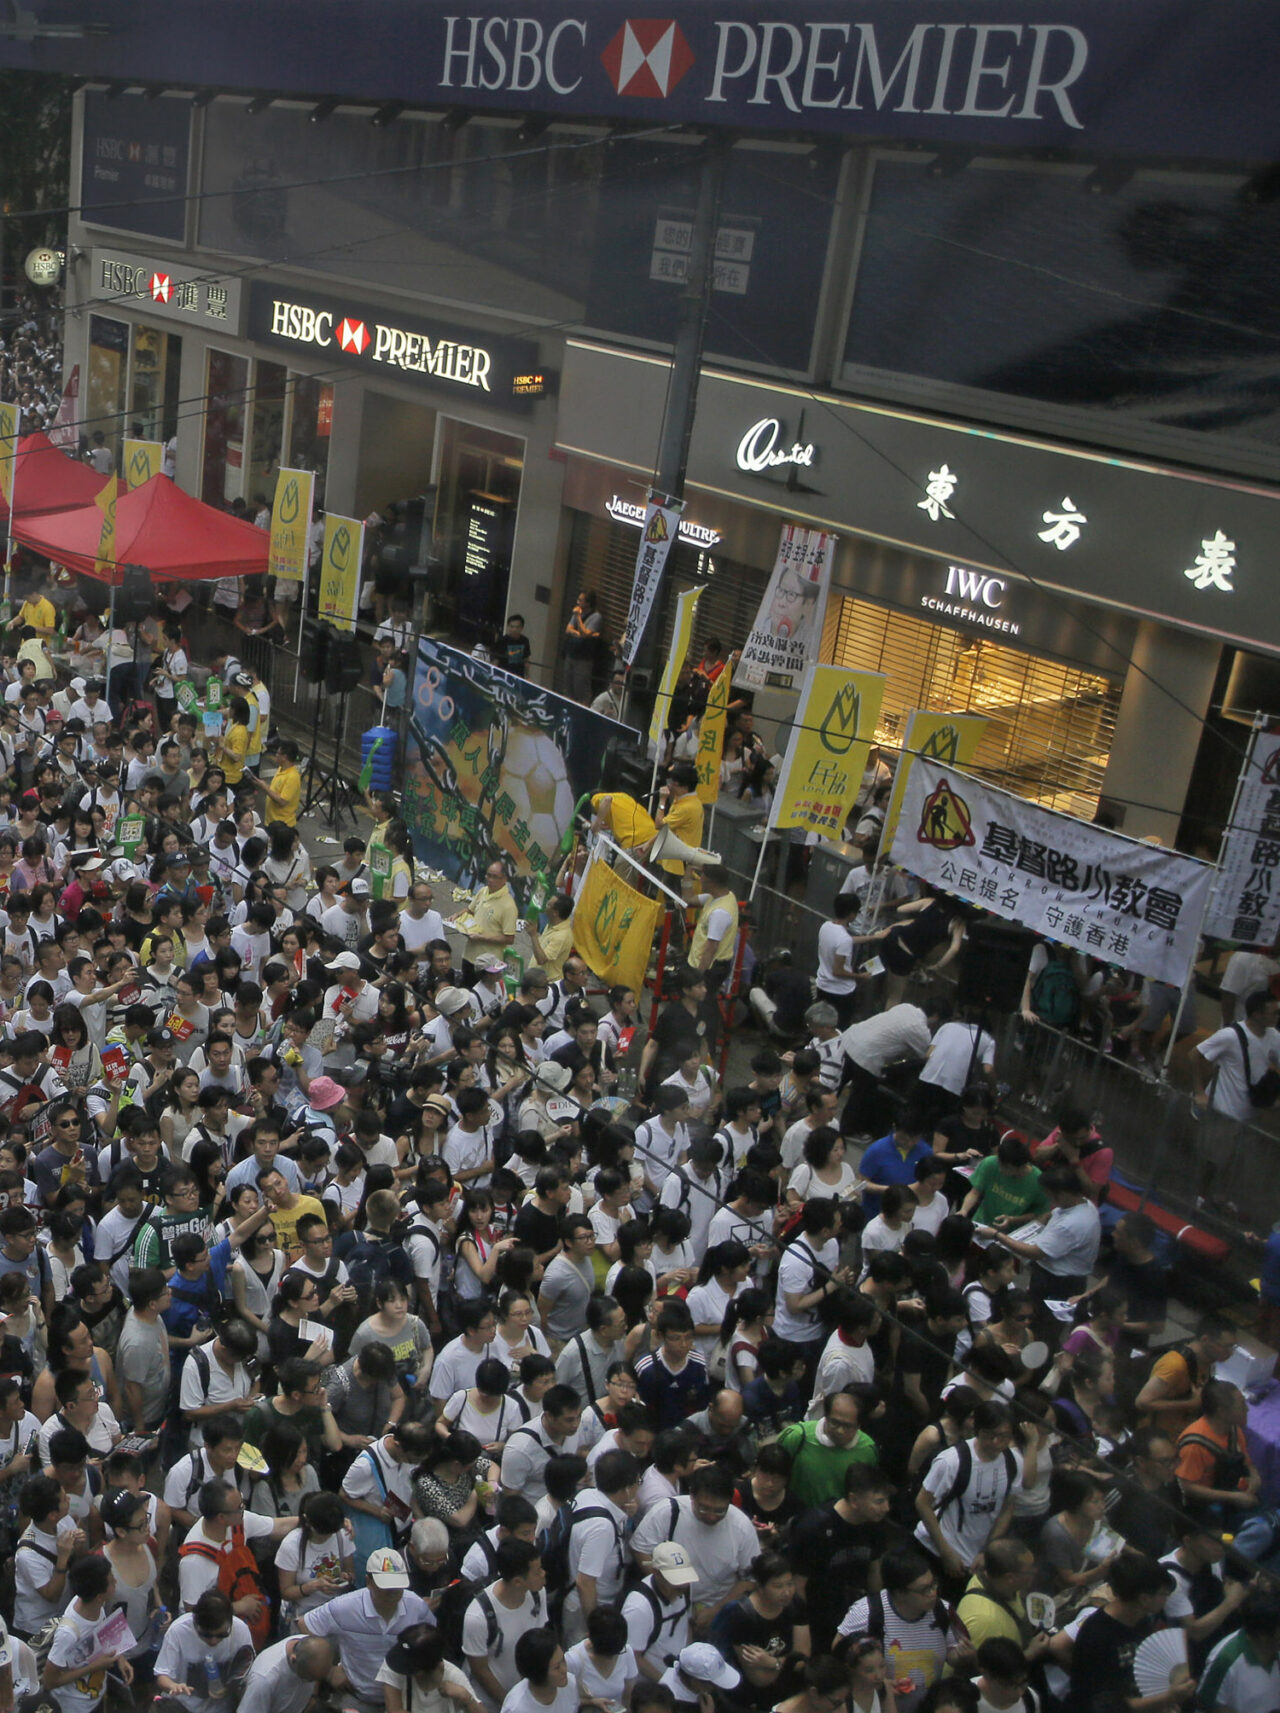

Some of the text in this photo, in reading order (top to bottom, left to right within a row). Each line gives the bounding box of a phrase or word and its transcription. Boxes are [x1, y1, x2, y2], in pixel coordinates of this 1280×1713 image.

[437, 16, 1088, 130] HSBC PREMIER
[101, 258, 148, 299] HSBC
[271, 301, 492, 393] HSBC PREMIER
[920, 596, 1020, 636] SCHAFFHAUSEN
[943, 564, 1006, 610] IWC
[940, 860, 1130, 957] 公民提名 守護香港
[977, 859, 1065, 903] NARROW
[978, 820, 1184, 931] 基督路小教會
